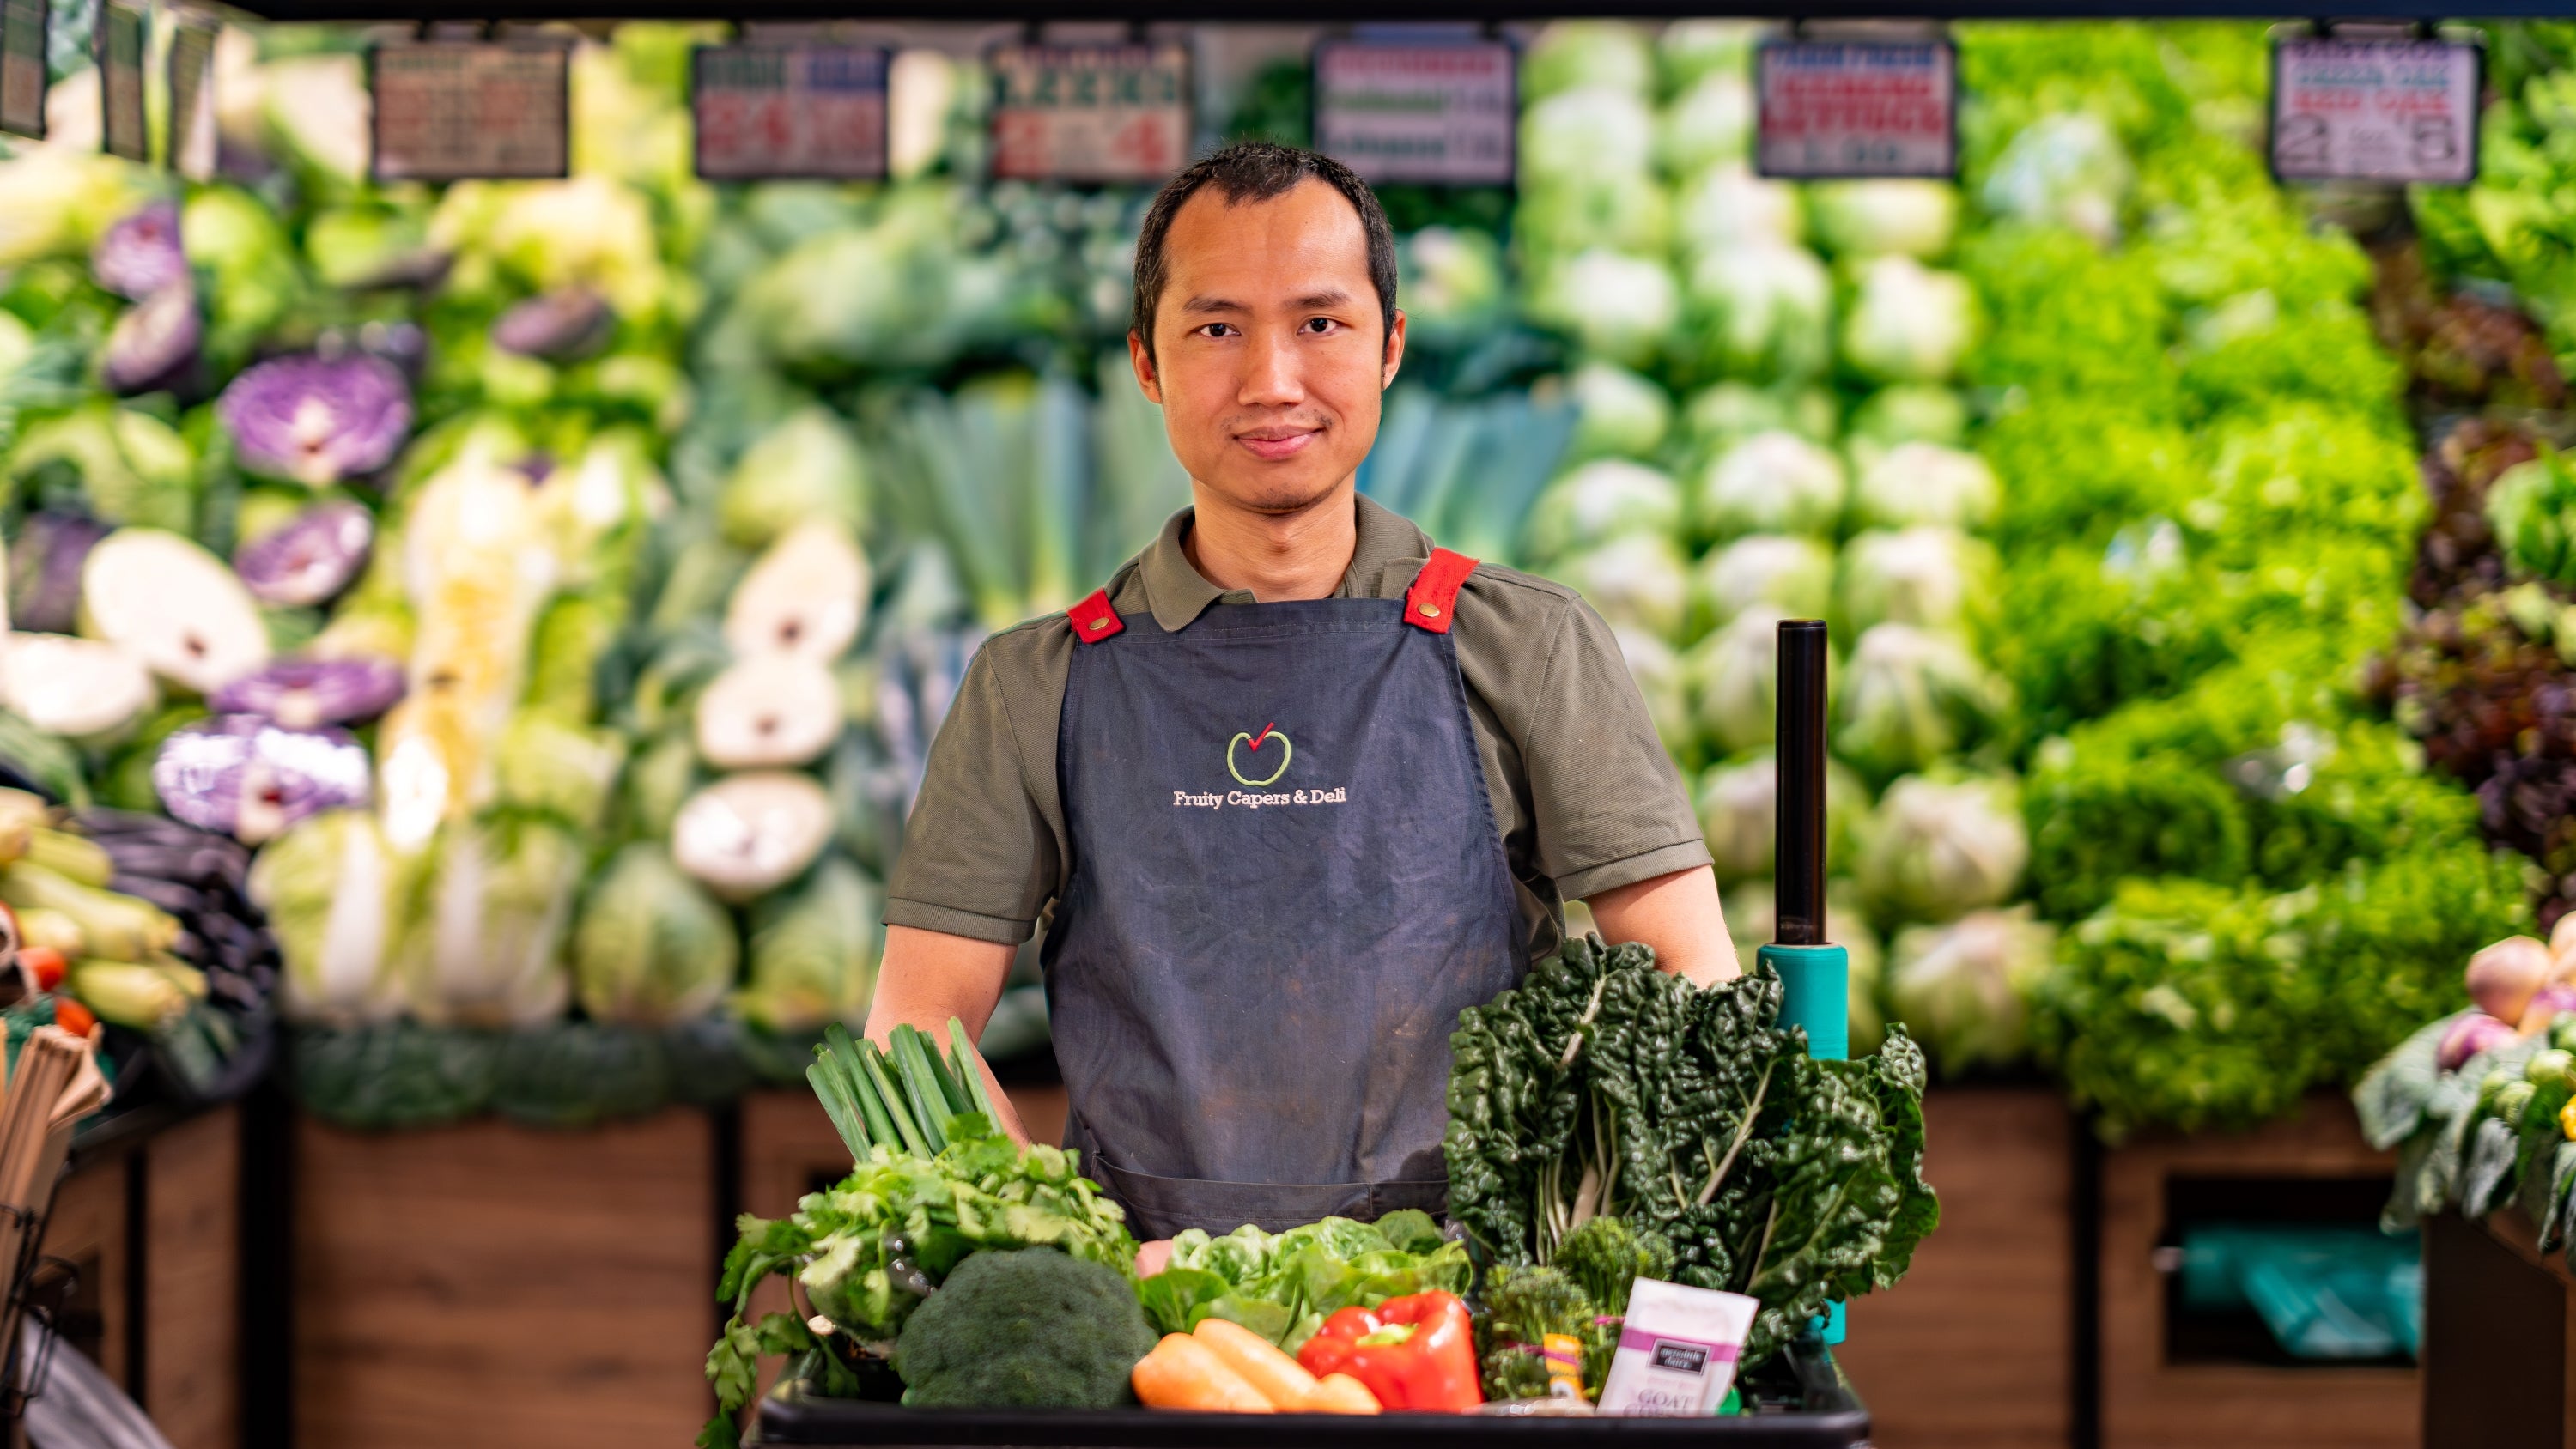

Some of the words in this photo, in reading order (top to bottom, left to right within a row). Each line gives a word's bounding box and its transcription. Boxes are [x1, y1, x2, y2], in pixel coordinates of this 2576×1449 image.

[1173, 791, 1224, 810] Fruity
[1227, 790, 1291, 809] Capers
[1293, 790, 1308, 805] &
[1309, 786, 1346, 804] Deli
[1637, 1388, 1694, 1409] GOAT
